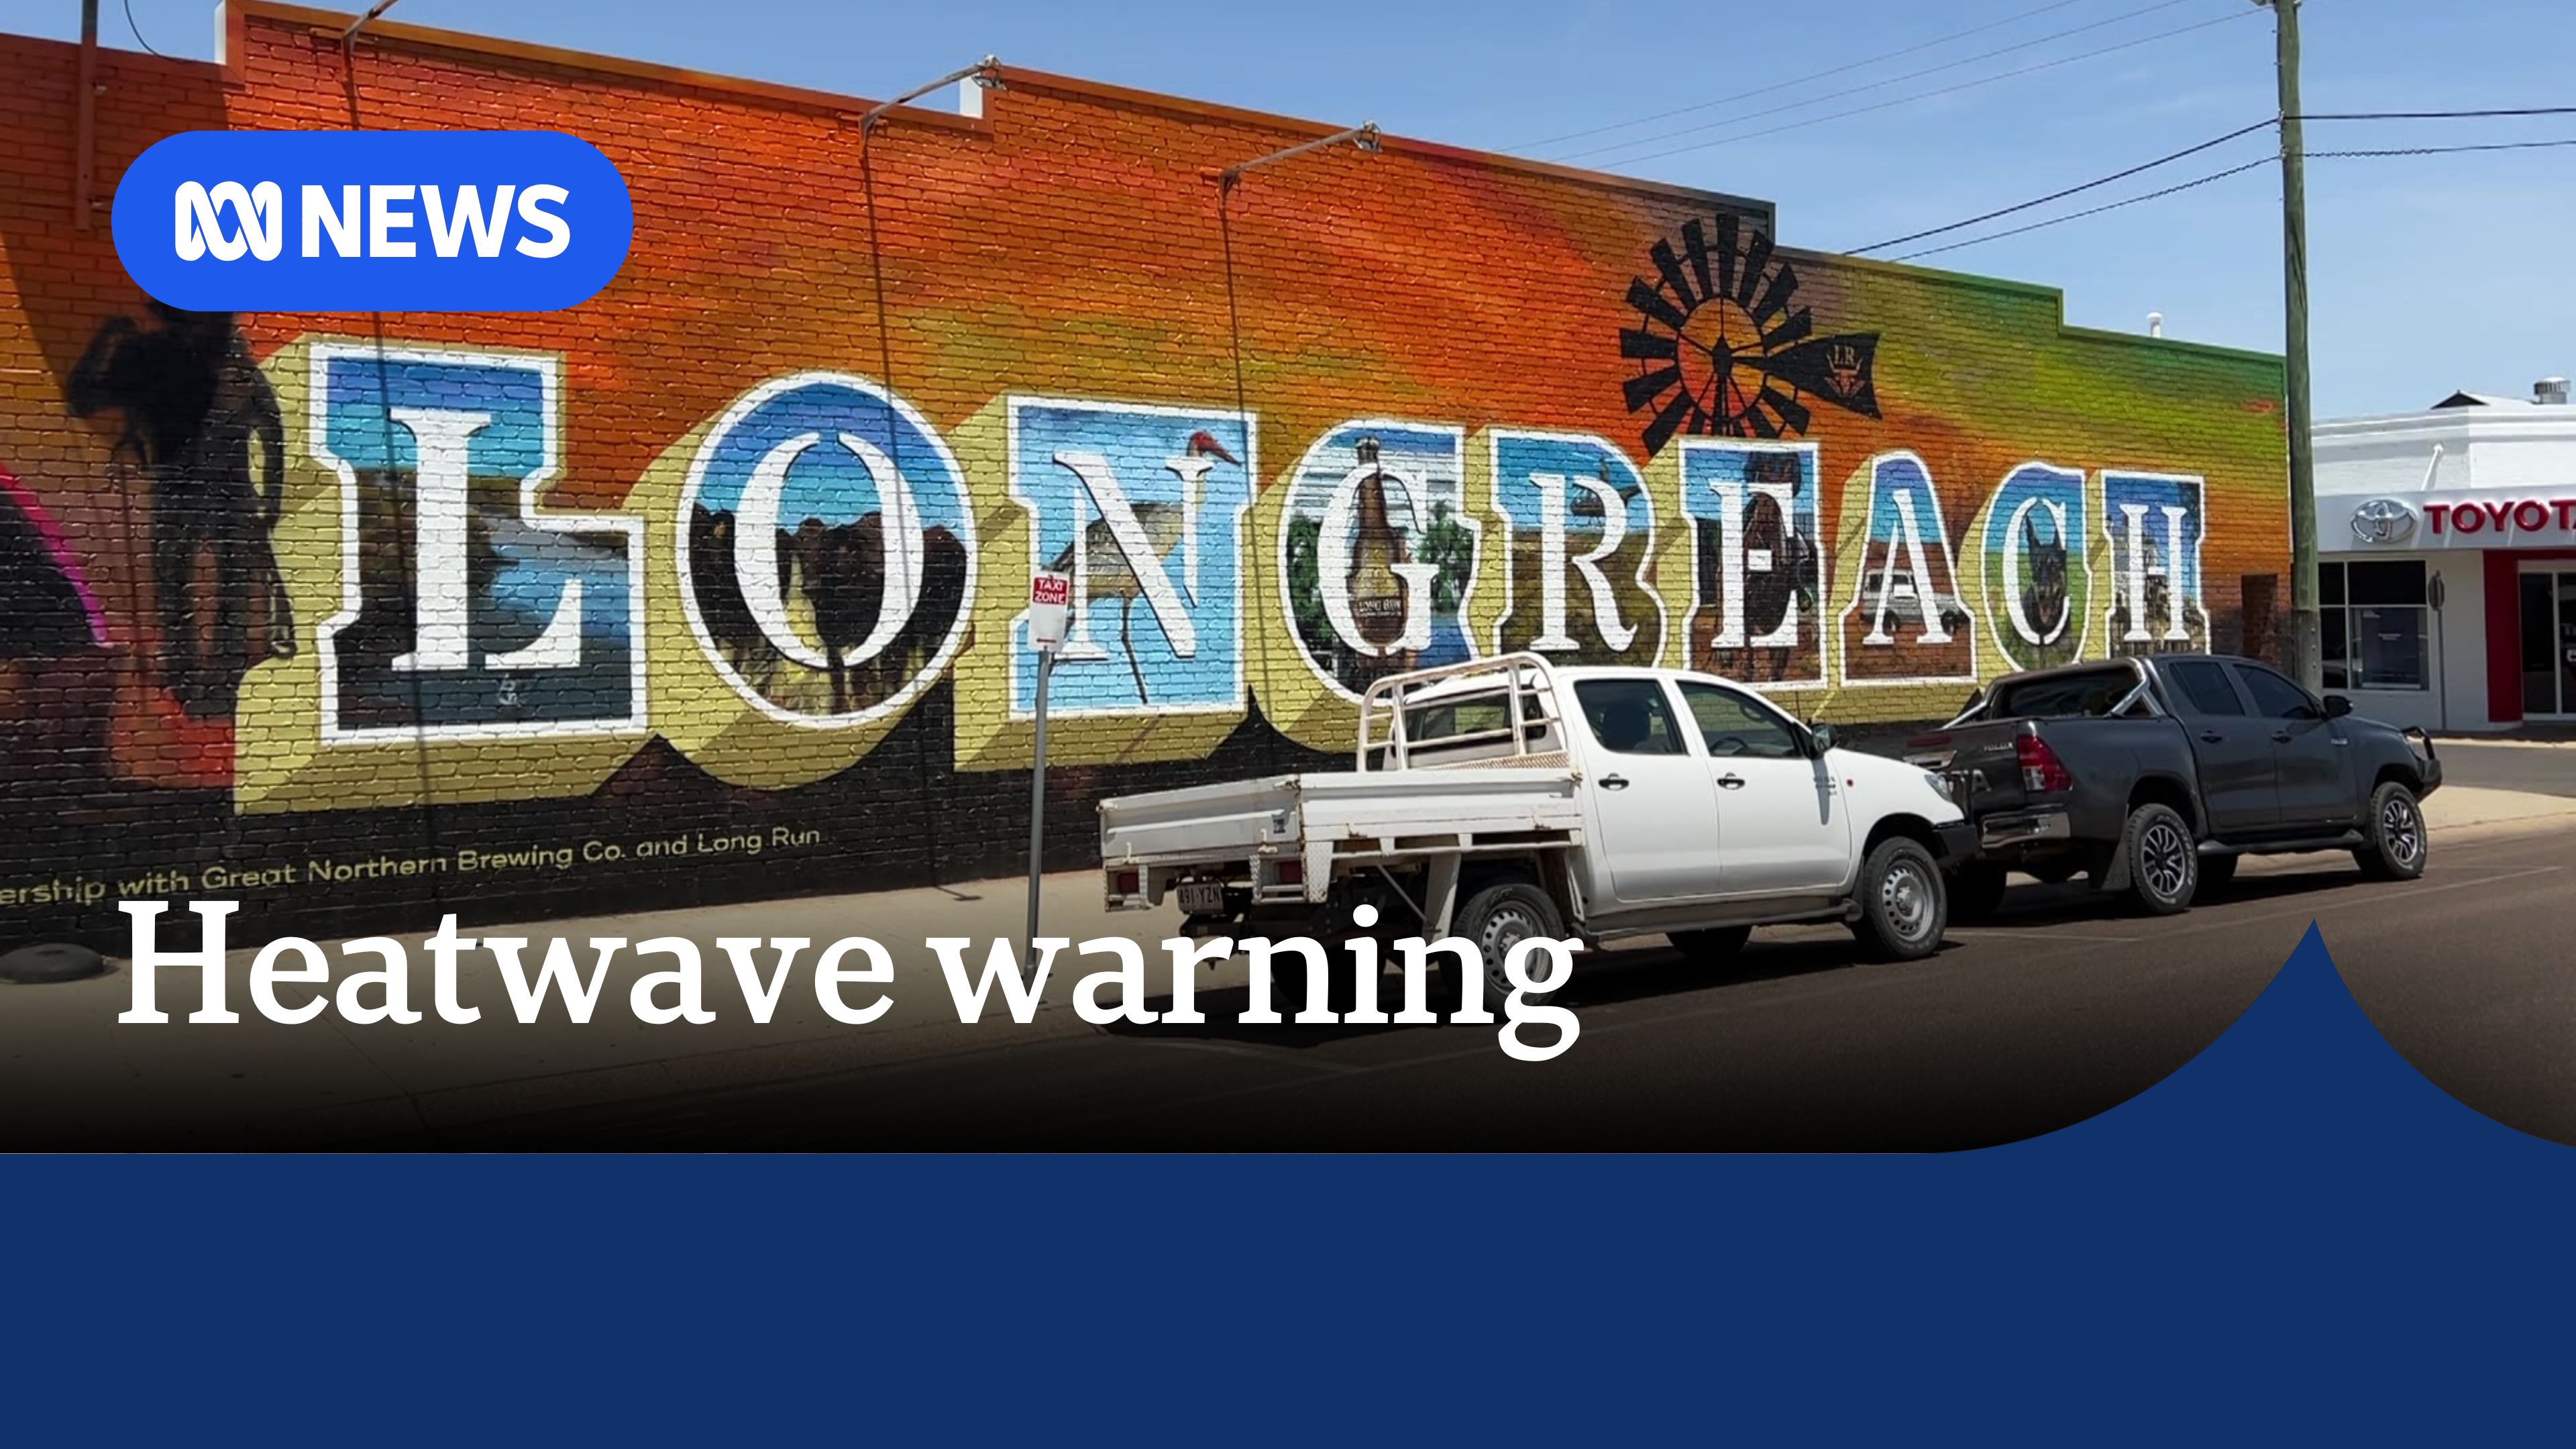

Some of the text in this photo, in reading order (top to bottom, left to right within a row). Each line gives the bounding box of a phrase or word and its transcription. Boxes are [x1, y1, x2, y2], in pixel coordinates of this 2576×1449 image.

[2424, 499, 2576, 535] TOYOT
[309, 341, 2212, 748] LONGREACH
[1035, 592, 1065, 603] ZONE
[1038, 580, 1063, 590] TAXI
[119, 871, 190, 897] with
[201, 861, 296, 890] Great
[309, 855, 447, 883] Northern
[458, 843, 574, 872] Brewing
[582, 839, 626, 863] Co.
[636, 834, 688, 858] and
[698, 832, 763, 856] Long
[771, 826, 821, 847] Run
